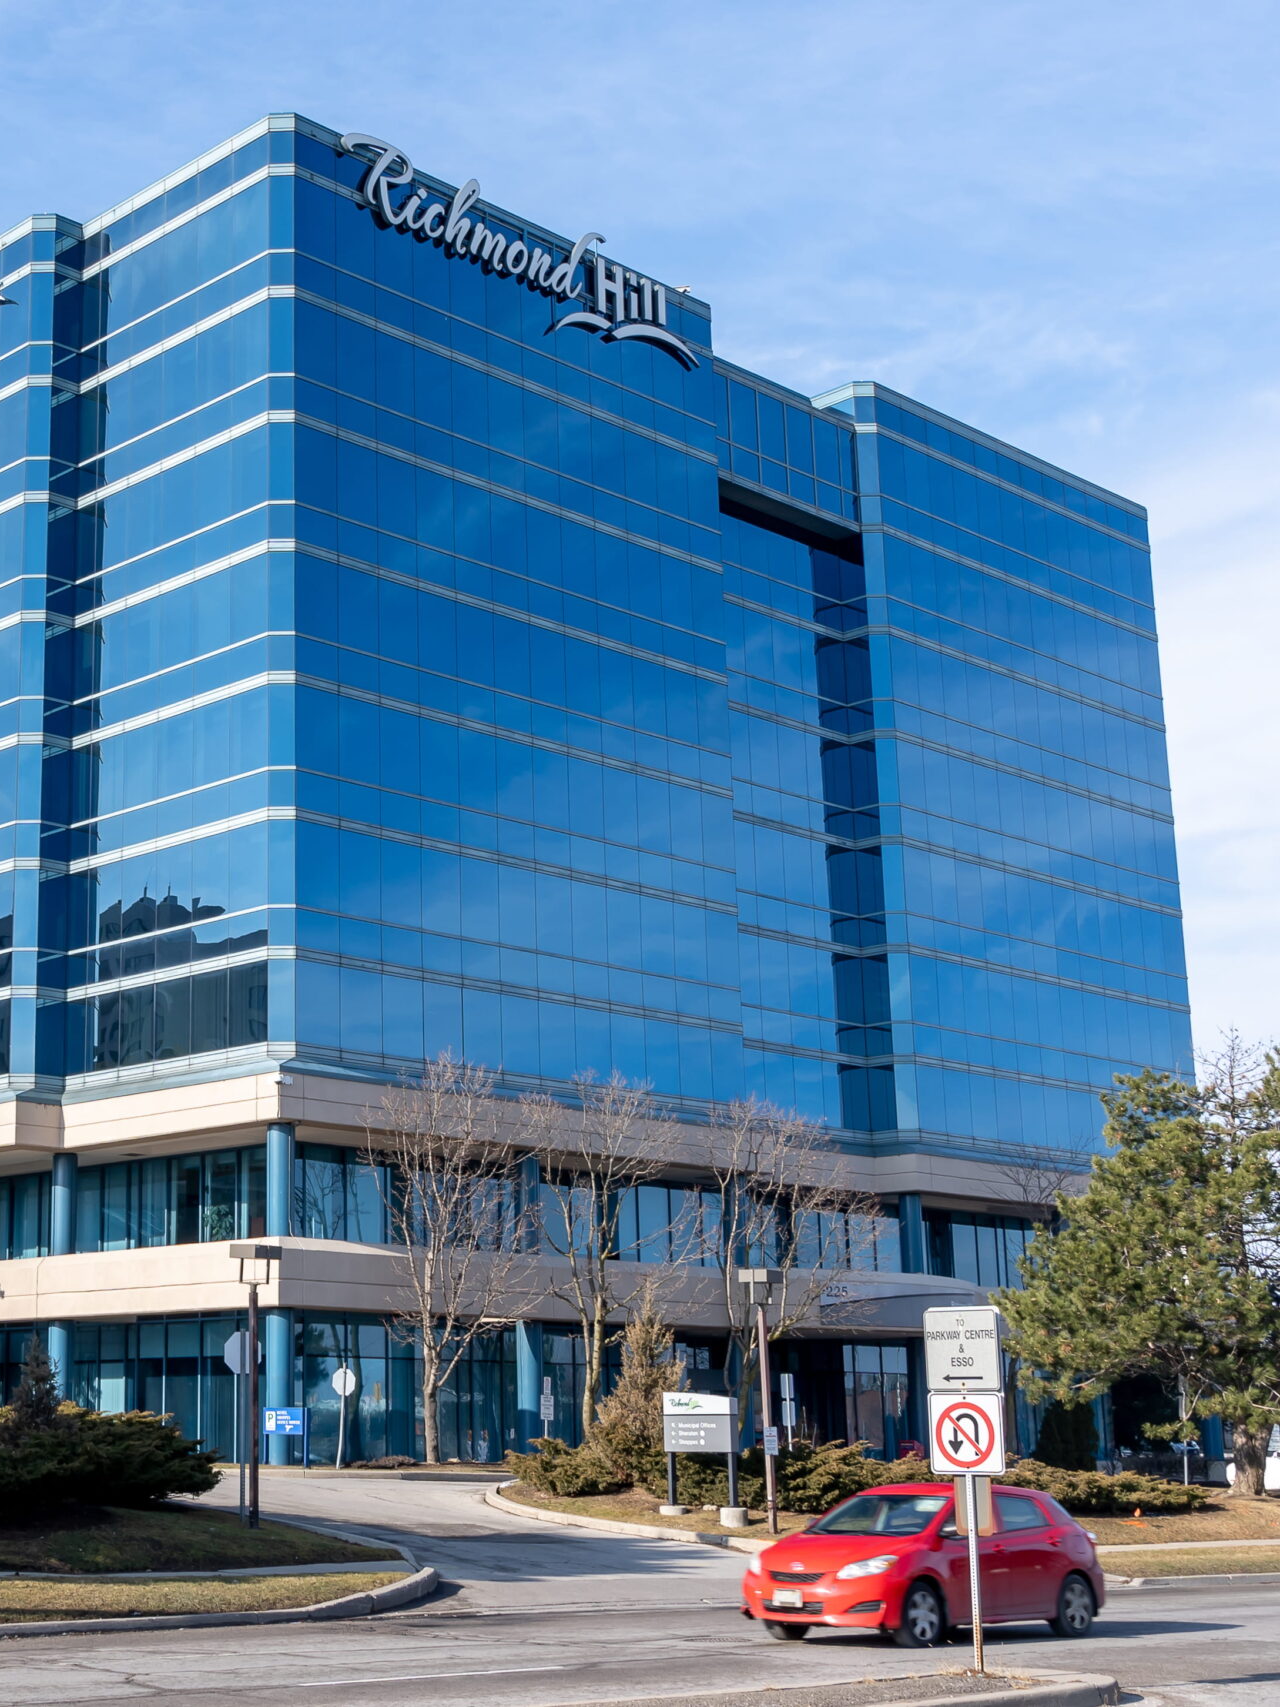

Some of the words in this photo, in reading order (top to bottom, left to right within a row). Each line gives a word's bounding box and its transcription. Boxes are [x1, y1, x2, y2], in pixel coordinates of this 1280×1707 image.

[341, 132, 607, 300] Richmond
[596, 256, 667, 327] Hill
[956, 1318, 965, 1327] TO
[926, 1330, 961, 1341] PARKWAY
[964, 1328, 995, 1340] CENTRE
[958, 1343, 965, 1354] &
[951, 1357, 974, 1367] ESSO
